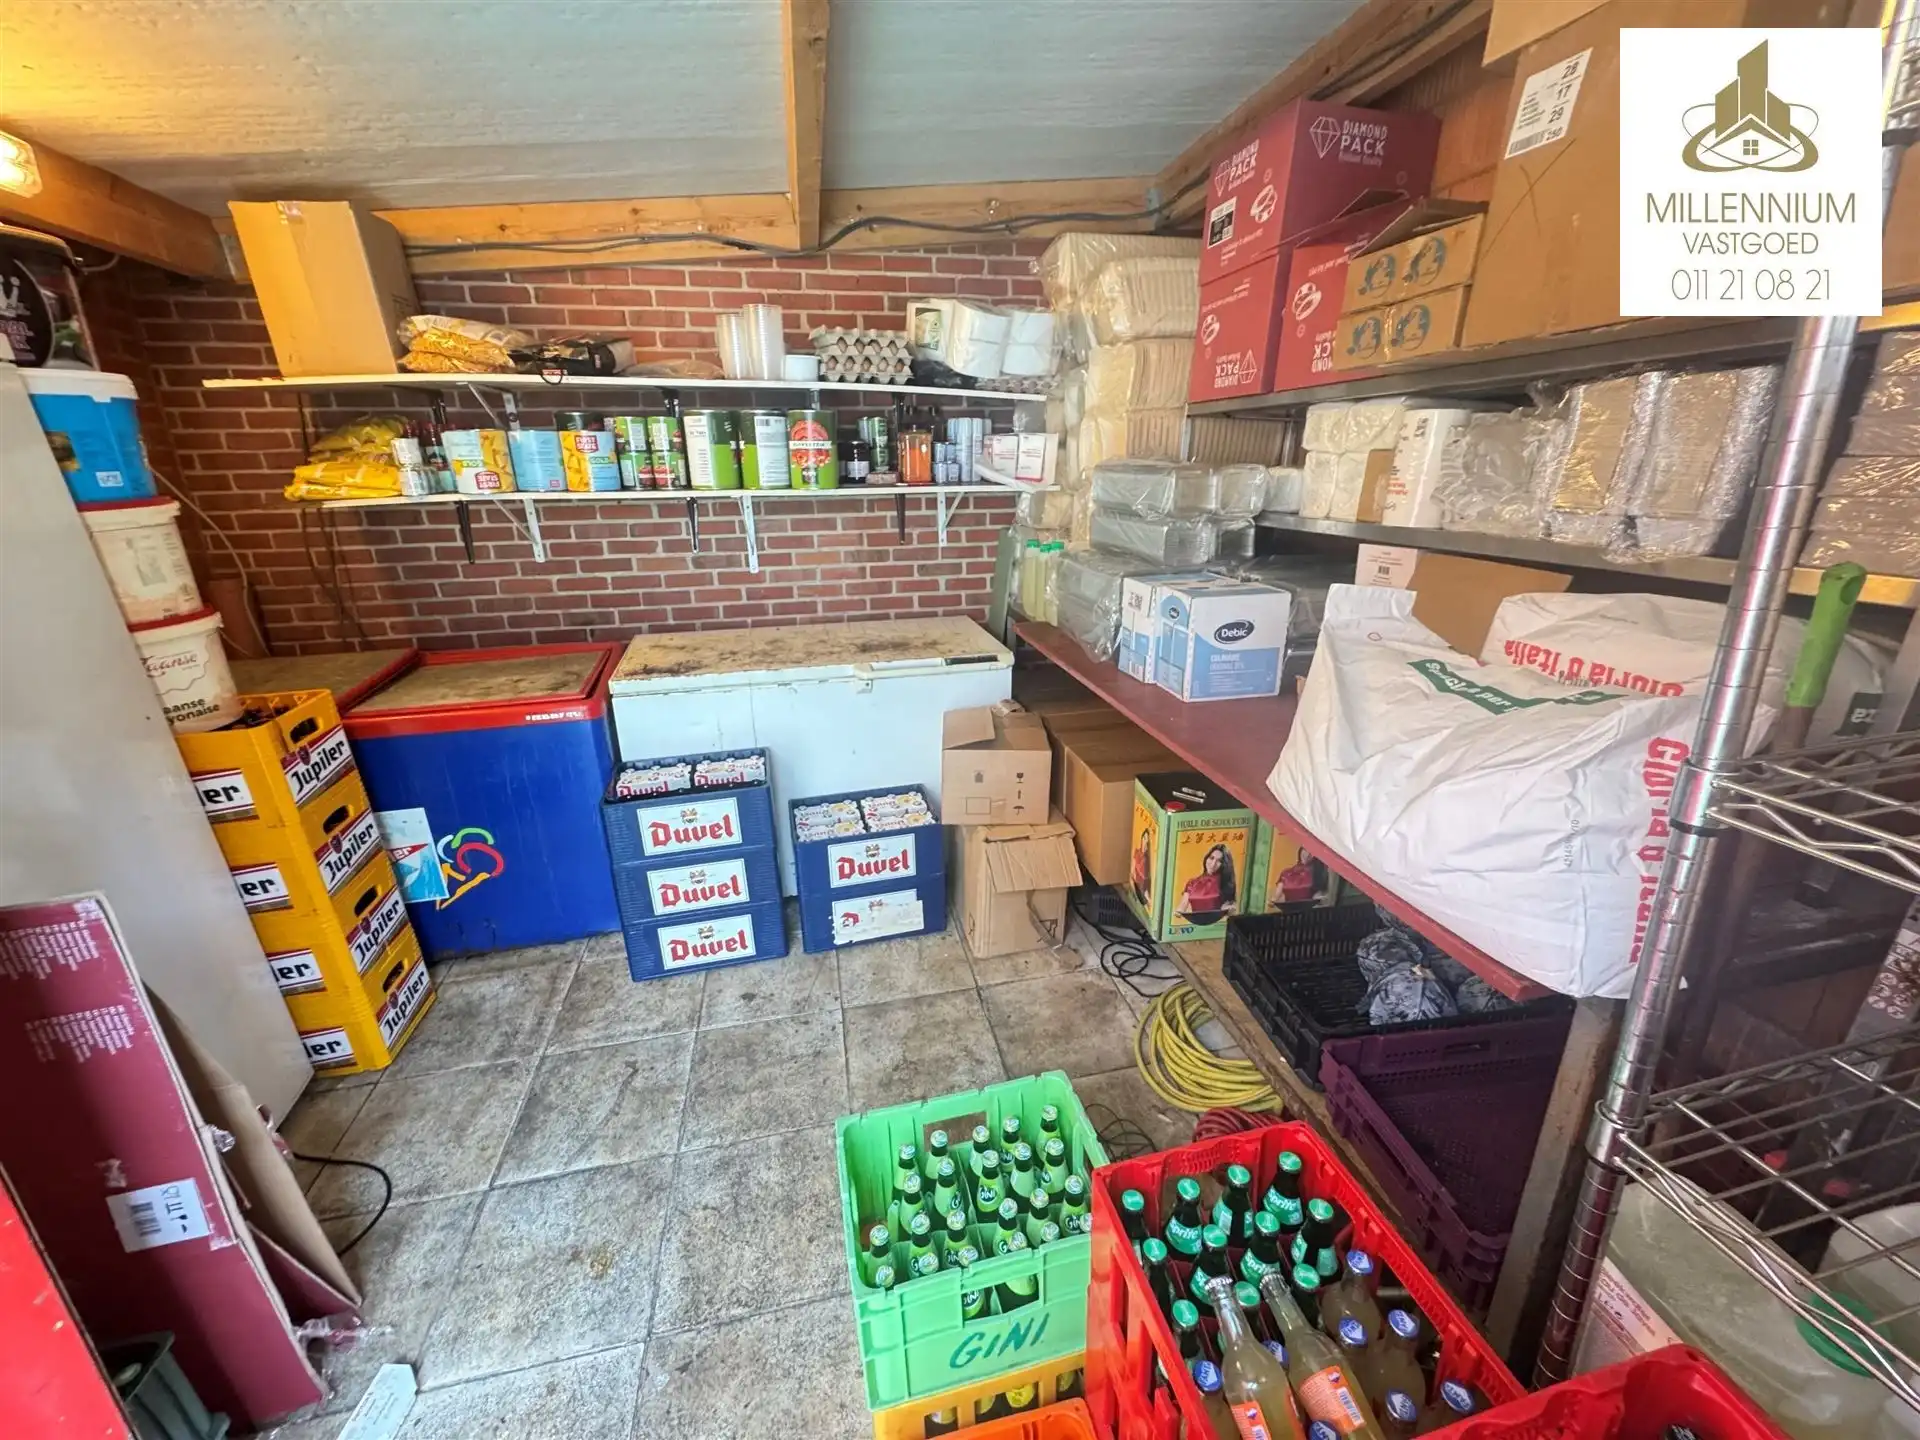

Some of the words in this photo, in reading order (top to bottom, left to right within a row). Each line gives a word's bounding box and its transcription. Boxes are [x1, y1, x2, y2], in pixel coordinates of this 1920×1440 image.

[1557, 83, 1573, 100] 17
[1342, 120, 1388, 139] DIAMOND
[1231, 138, 1260, 166] DIAMOND
[1340, 135, 1386, 156] PACK
[1229, 152, 1257, 180] PACK
[1215, 361, 1240, 377] PACK
[1220, 625, 1248, 637] Debic
[291, 738, 346, 794] Jupiler
[648, 814, 734, 848] Duvel
[324, 822, 374, 885] Jupiler
[836, 849, 910, 881] Duvel
[657, 874, 742, 908] Duvel
[353, 898, 400, 965] Jupiler
[667, 929, 749, 963] Duvel
[382, 970, 426, 1041] Jupiler
[1267, 1187, 1297, 1211] Sprite
[1169, 1218, 1199, 1241] Sprite
[949, 1313, 1050, 1370] GINI
